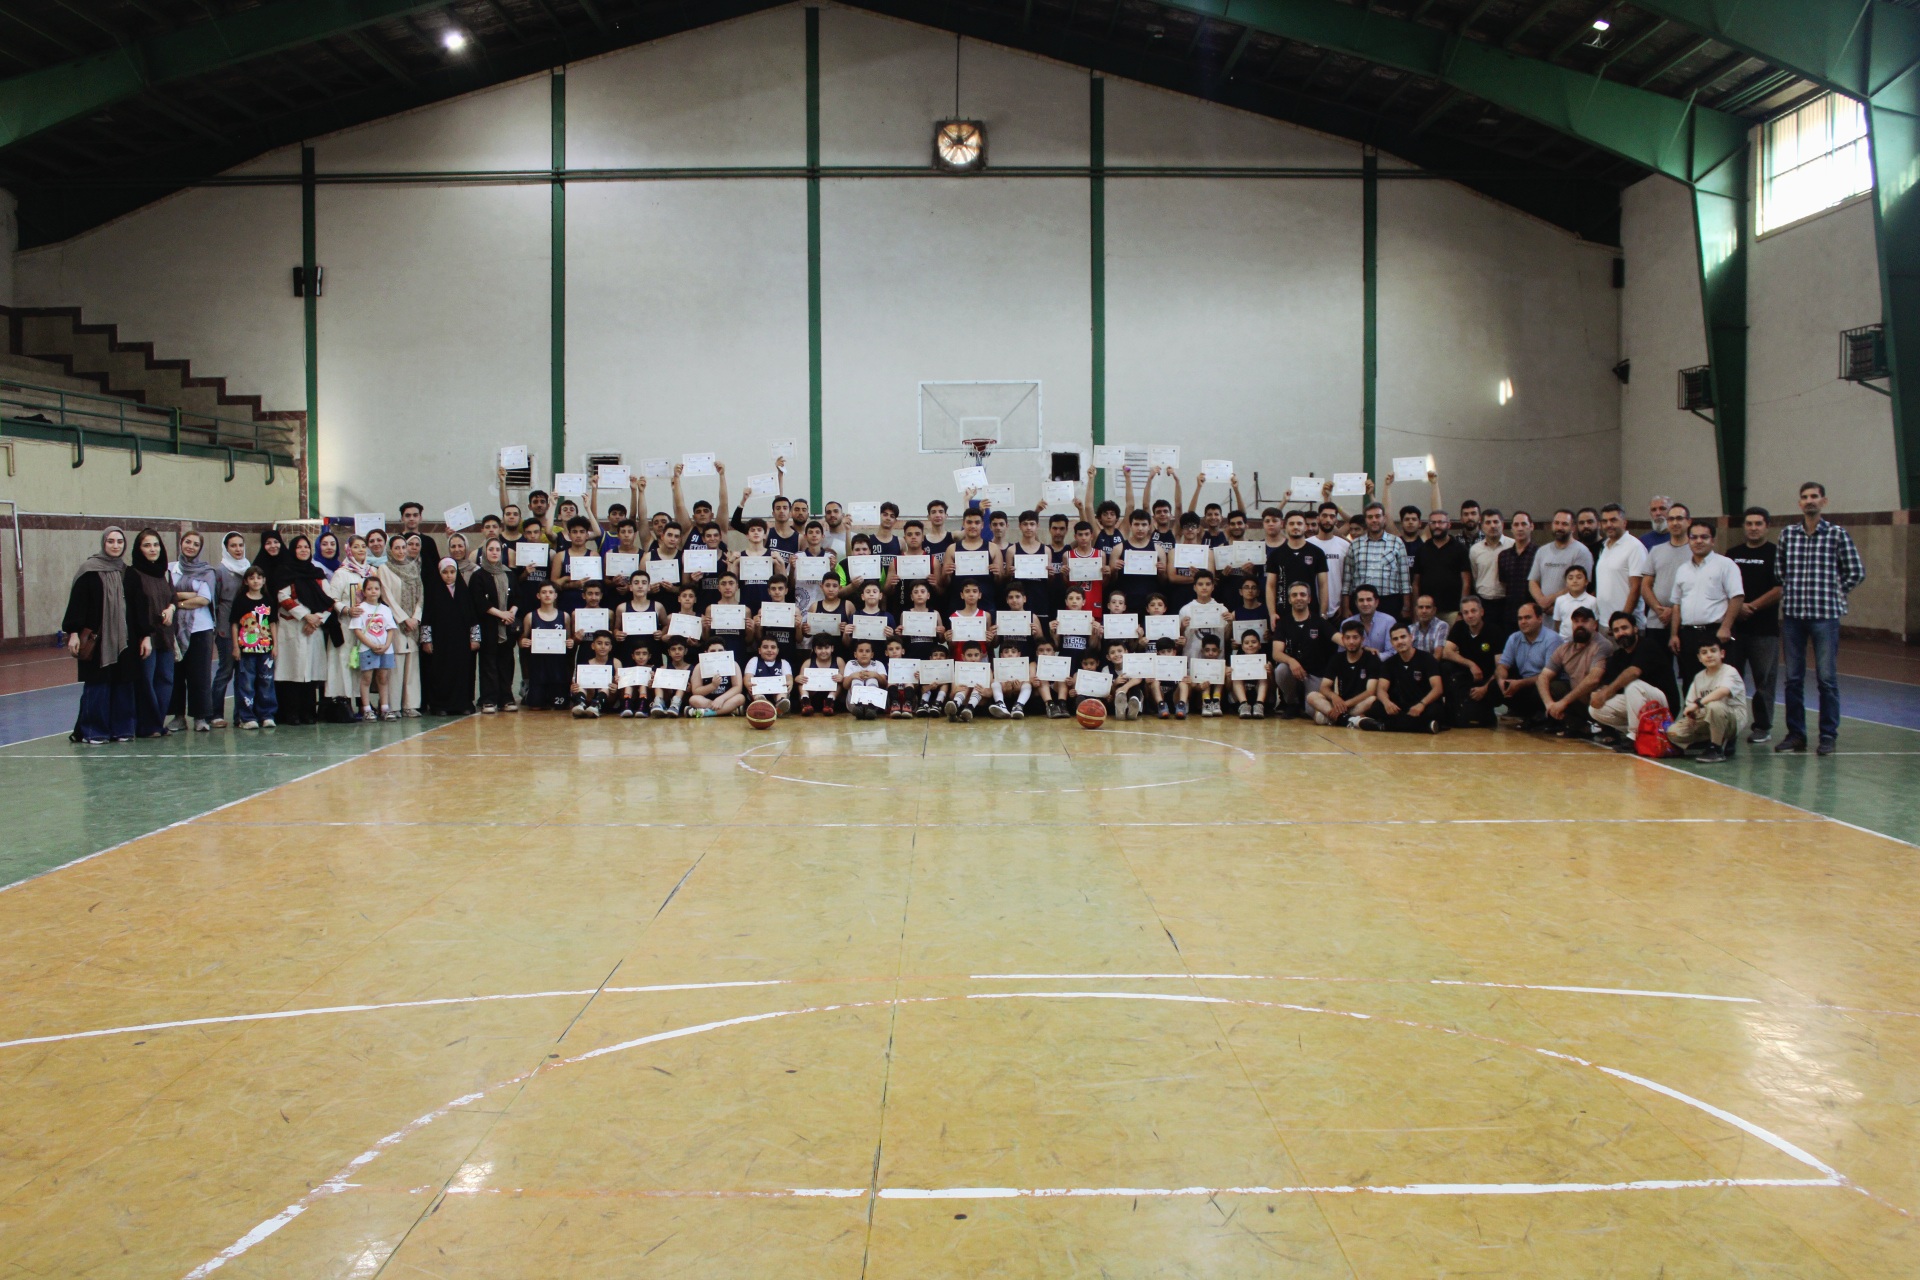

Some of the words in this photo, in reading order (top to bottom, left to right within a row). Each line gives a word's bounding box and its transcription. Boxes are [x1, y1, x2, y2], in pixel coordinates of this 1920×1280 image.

[691, 534, 699, 542] 91
[770, 539, 778, 548] 19
[872, 545, 882, 553] 20
[554, 697, 565, 705] 29
